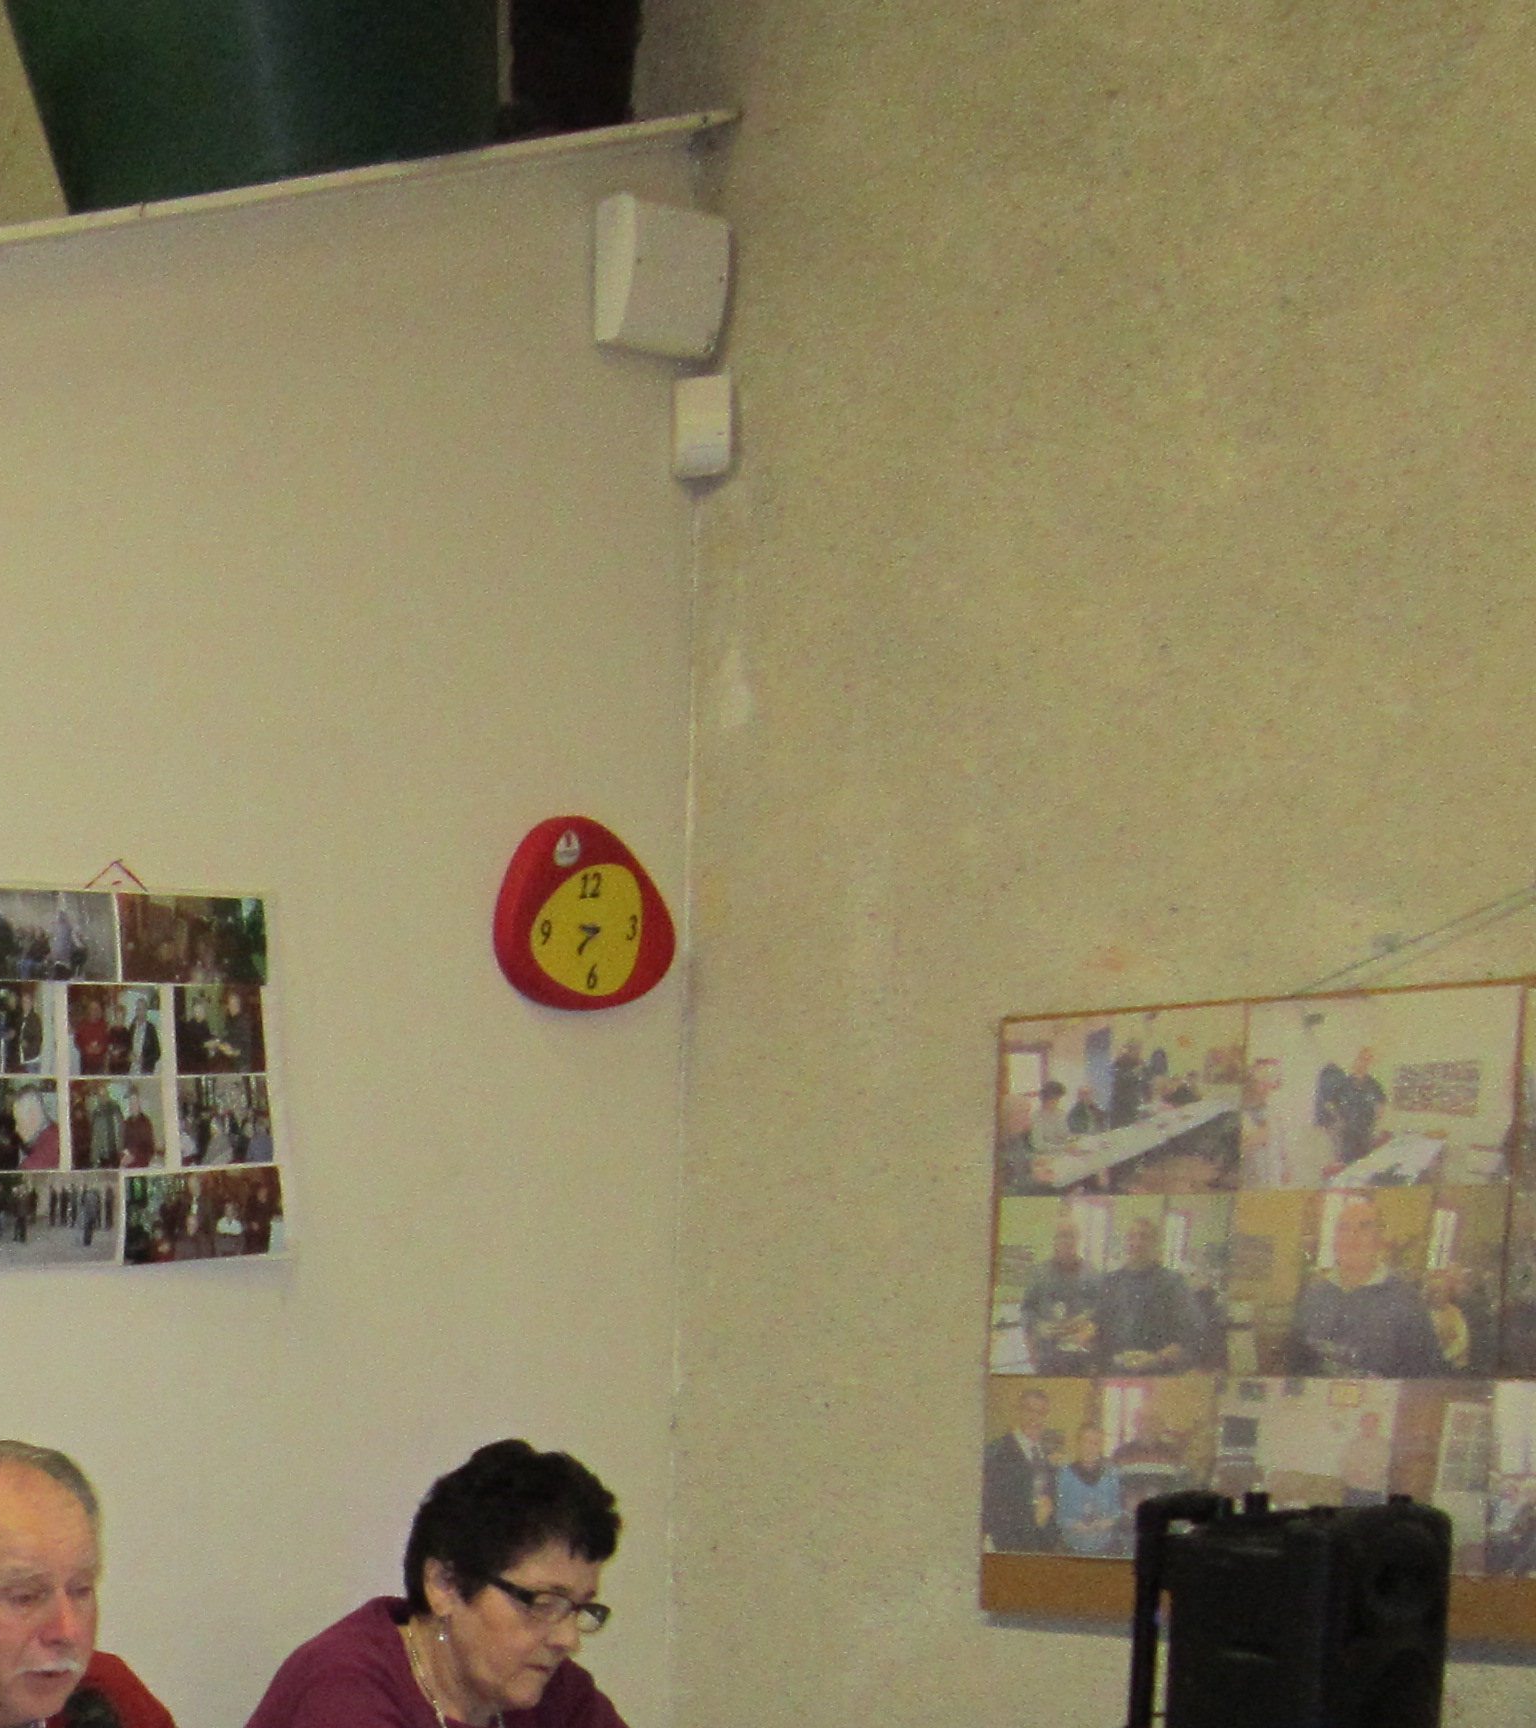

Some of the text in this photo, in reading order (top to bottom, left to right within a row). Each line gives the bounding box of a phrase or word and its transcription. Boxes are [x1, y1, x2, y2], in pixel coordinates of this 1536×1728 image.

[579, 872, 602, 899] 12
[540, 919, 552, 946] 9
[586, 963, 598, 990] 6
